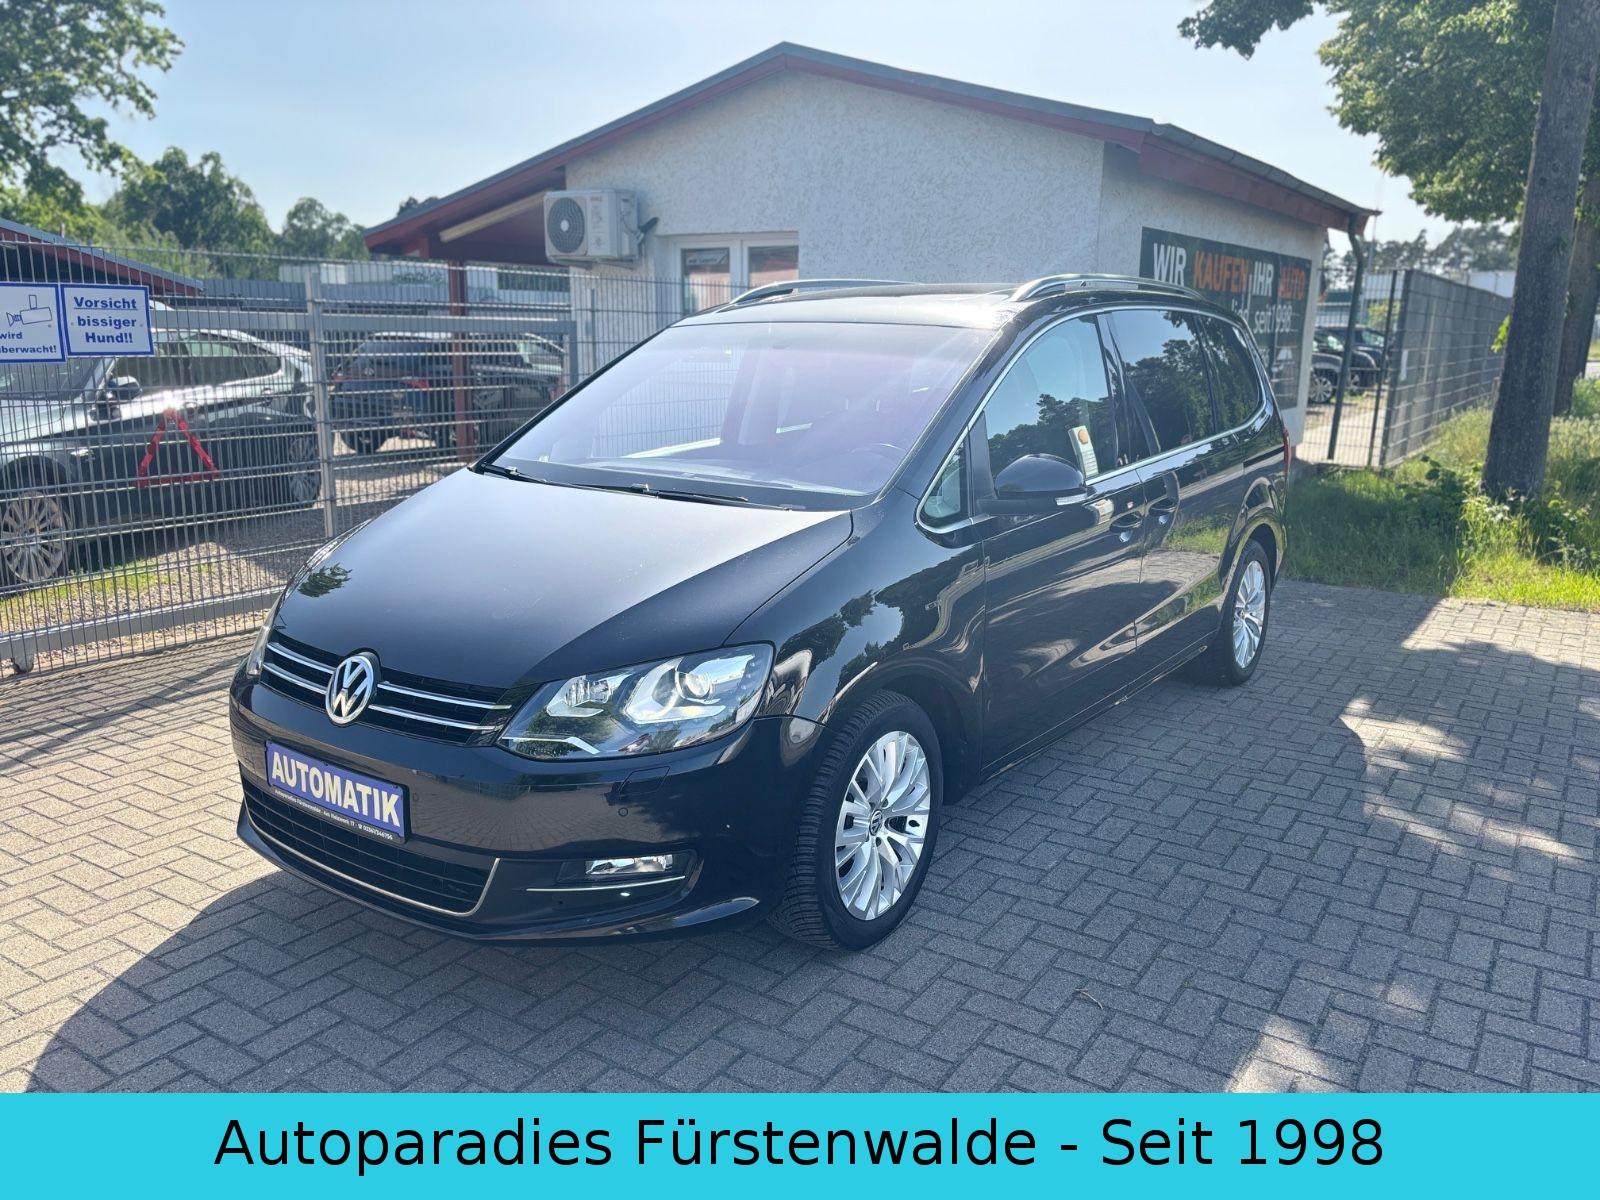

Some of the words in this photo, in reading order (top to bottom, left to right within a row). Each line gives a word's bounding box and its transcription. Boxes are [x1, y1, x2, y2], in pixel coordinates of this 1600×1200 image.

[1153, 243, 1187, 287] WIR
[1193, 251, 1249, 294] KAUFEN
[1252, 261, 1275, 297] IHR
[1278, 266, 1306, 301] AUTO
[74, 296, 137, 309] Vorsicht
[77, 316, 137, 329] bissiger
[85, 332, 133, 343] Hund!!
[0, 345, 57, 353] berwacht!
[326, 656, 374, 724] VW
[272, 751, 400, 827] AUTOMATIK
